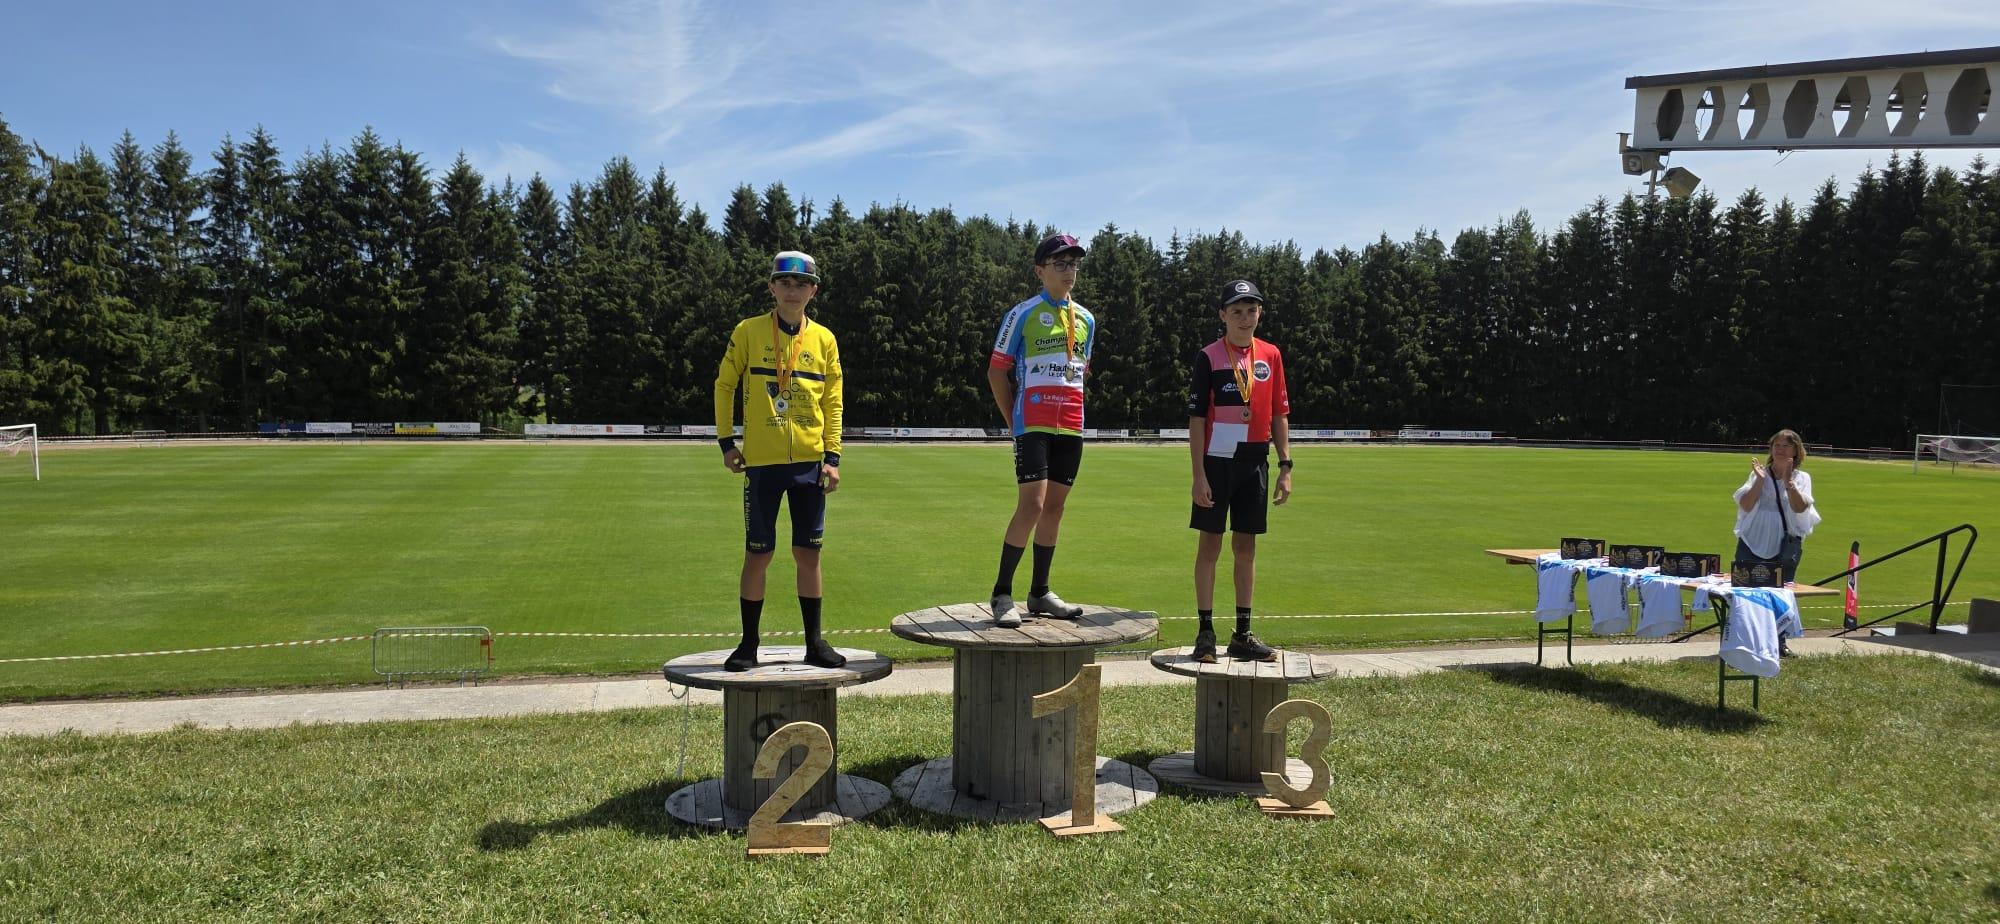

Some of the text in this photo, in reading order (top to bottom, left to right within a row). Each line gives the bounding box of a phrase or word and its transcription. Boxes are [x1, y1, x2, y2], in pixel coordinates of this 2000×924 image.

[748, 720, 834, 849] 2
[1032, 664, 1100, 827] 1
[1260, 699, 1331, 811] 3
